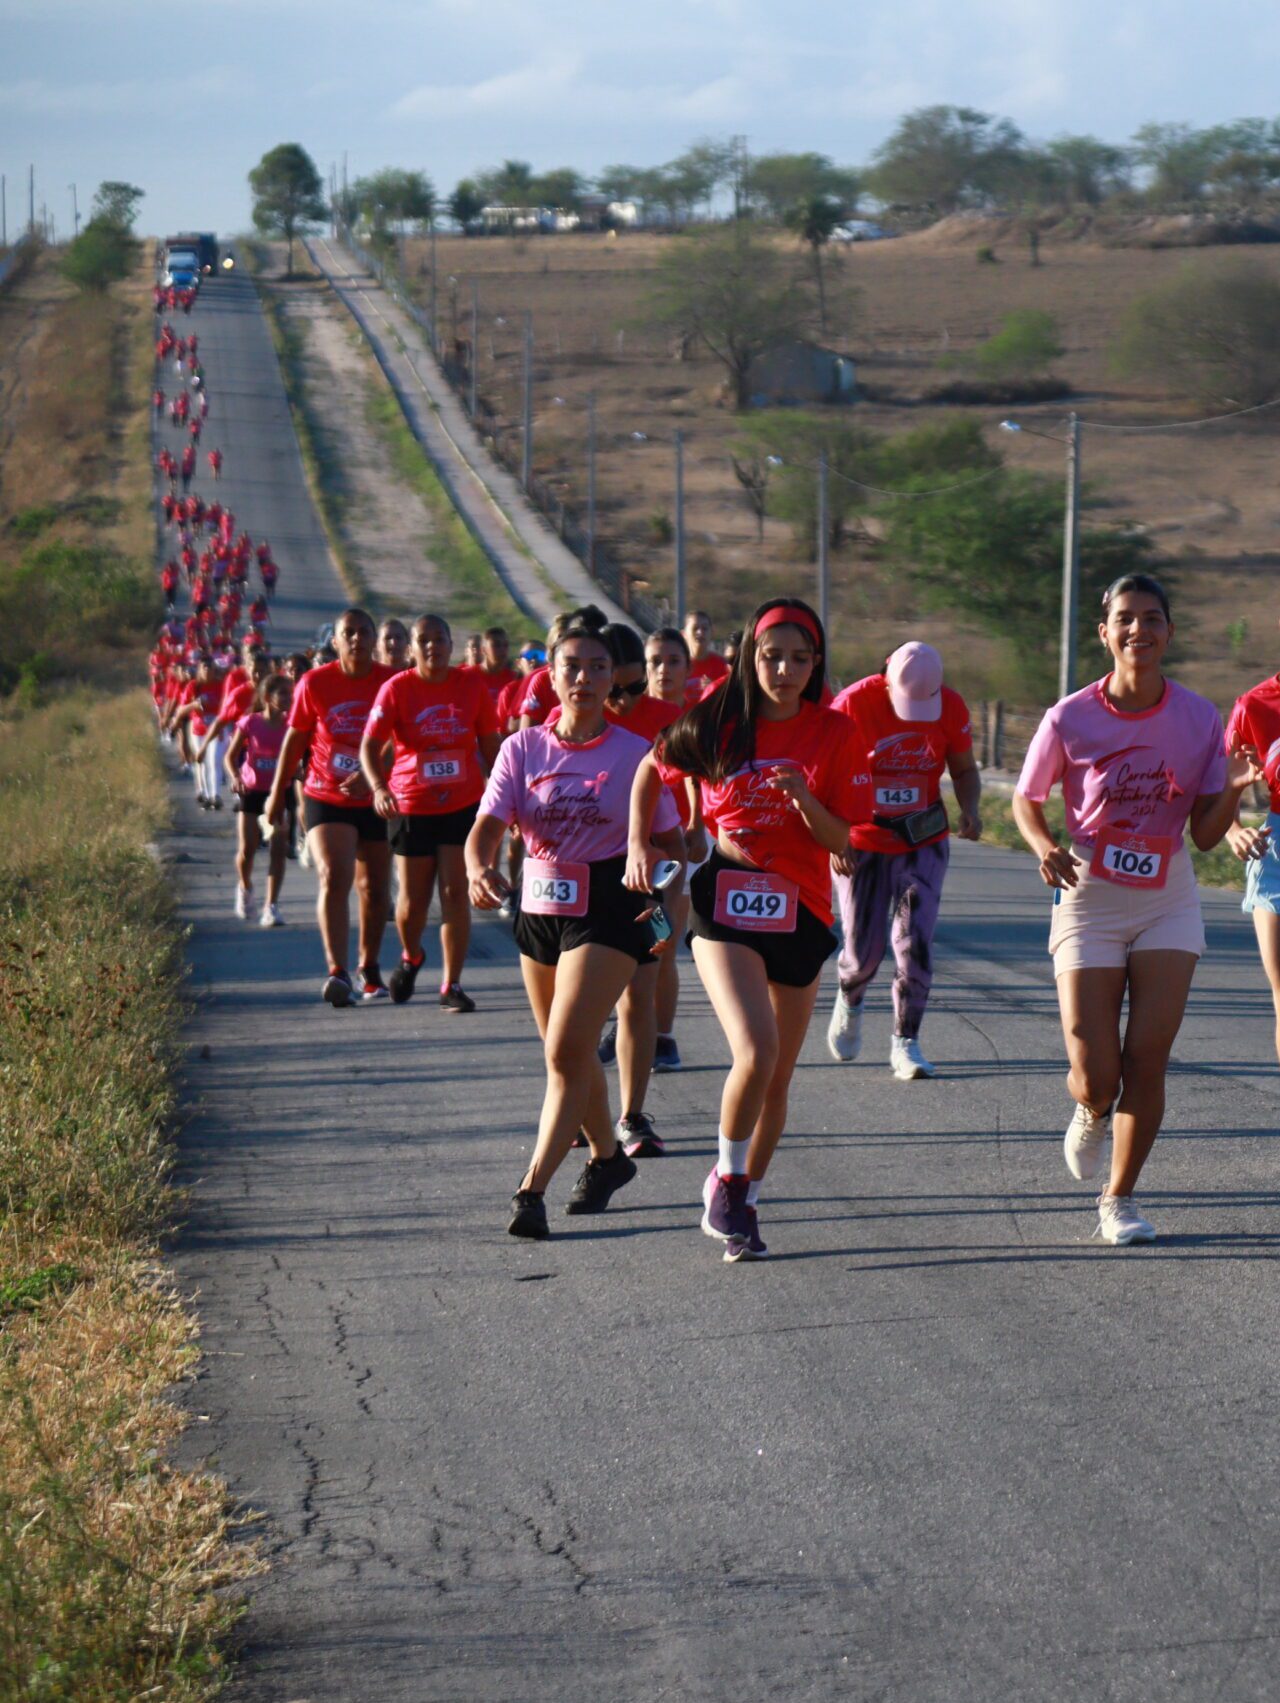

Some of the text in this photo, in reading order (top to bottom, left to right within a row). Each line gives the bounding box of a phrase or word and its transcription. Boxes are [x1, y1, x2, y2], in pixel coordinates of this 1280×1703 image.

[430, 761, 455, 776] 138
[1117, 759, 1168, 786] Corrida
[547, 785, 601, 807] Corrida
[883, 789, 913, 803] 143
[1100, 783, 1152, 807] Outubro
[1113, 849, 1153, 875] 106
[532, 879, 571, 901] 043
[731, 892, 781, 917] 049
